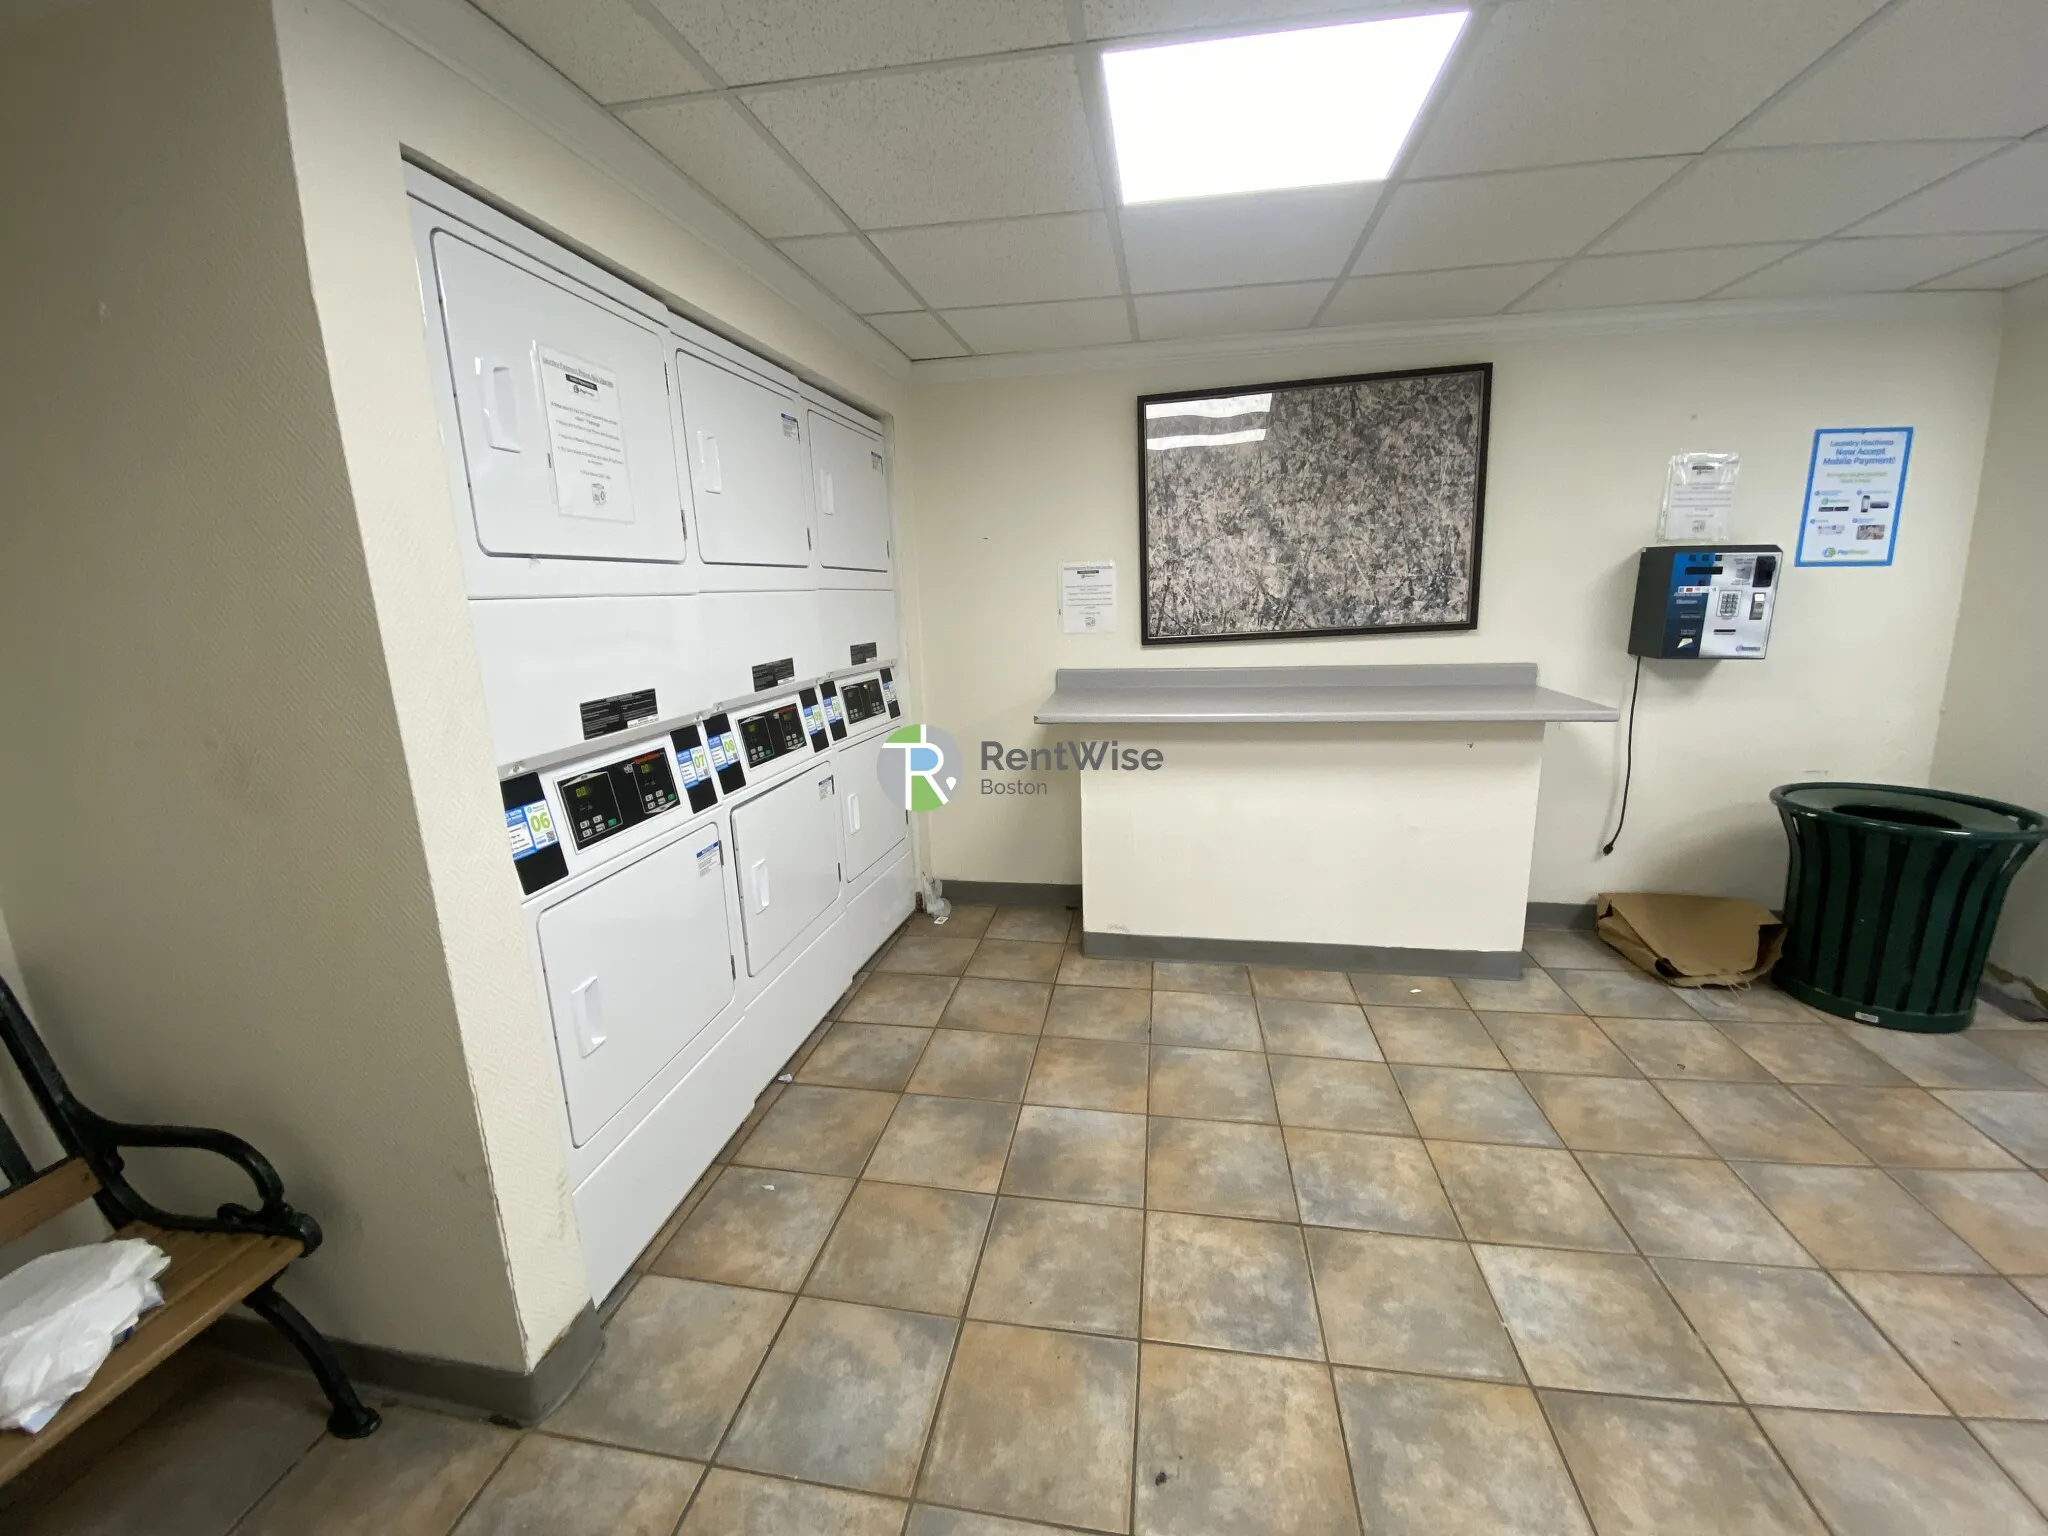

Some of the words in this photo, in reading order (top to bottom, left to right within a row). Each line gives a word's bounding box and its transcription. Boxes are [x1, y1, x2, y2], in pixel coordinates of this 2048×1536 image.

[1836, 448, 1856, 456] Now
[1857, 447, 1886, 456] Accept
[1823, 456, 1853, 465] Mobile
[1853, 456, 1896, 466] Payment!
[693, 753, 705, 768] 07
[530, 811, 551, 832] 06
